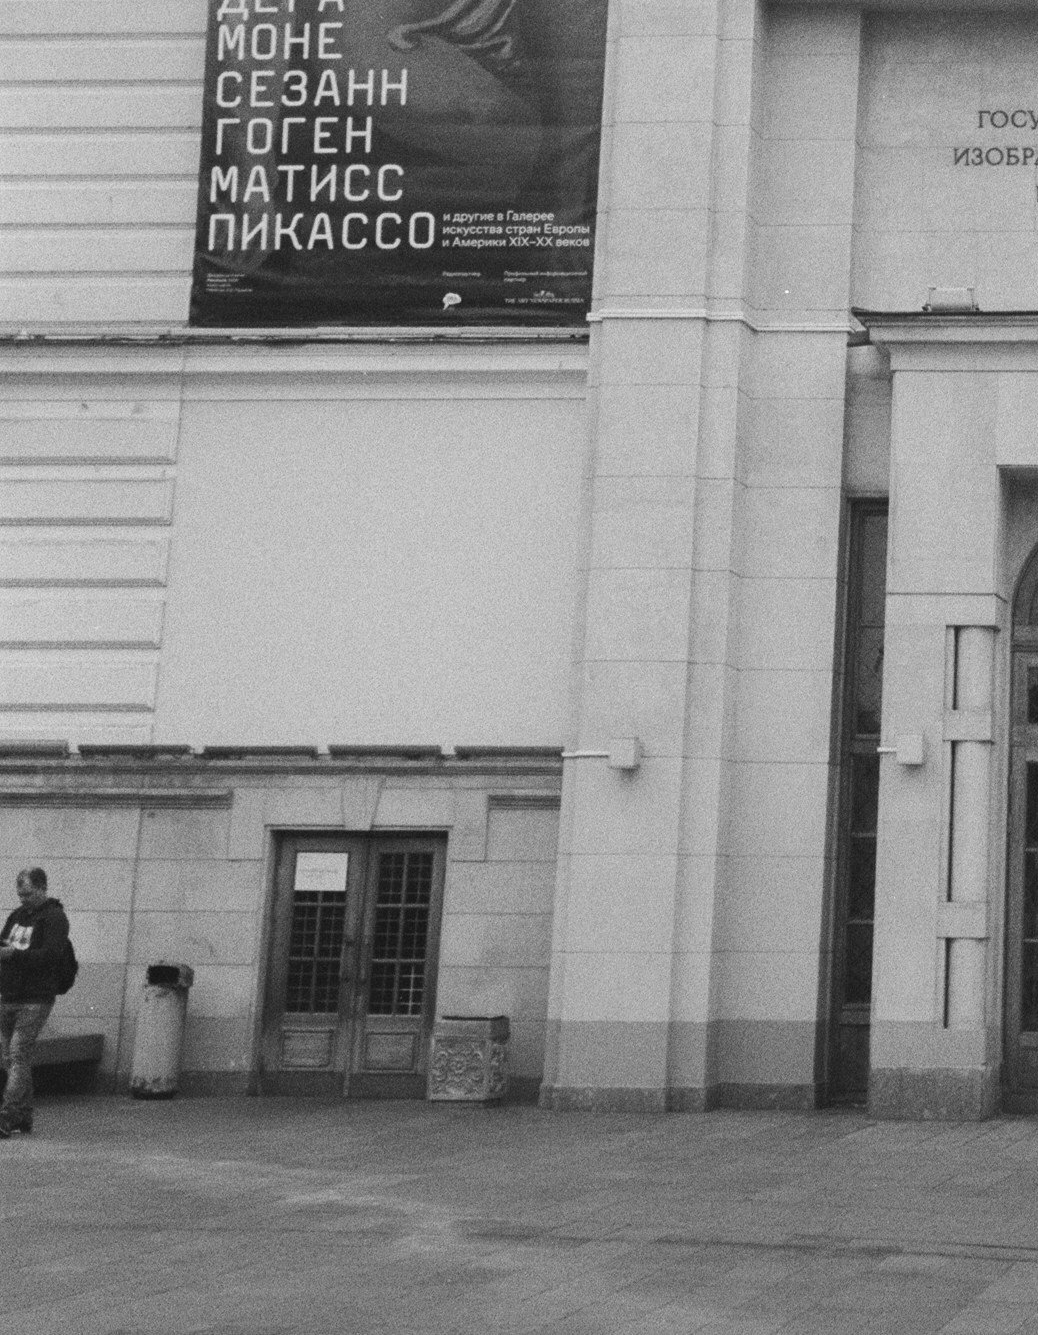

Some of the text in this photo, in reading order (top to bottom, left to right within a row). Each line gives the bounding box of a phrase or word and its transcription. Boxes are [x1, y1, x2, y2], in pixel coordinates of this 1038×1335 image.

[218, 22, 343, 60] МОНЕ
[217, 68, 408, 107] СЕЗАНН
[216, 116, 372, 155] ГОГЕН
[210, 164, 404, 203] МАТИСС
[208, 212, 435, 251] ПИКАССО
[442, 211, 554, 223] и другие в Галерее
[443, 223, 590, 235] искусства стран Европы
[441, 239, 450, 247] и
[453, 237, 506, 248] Америки
